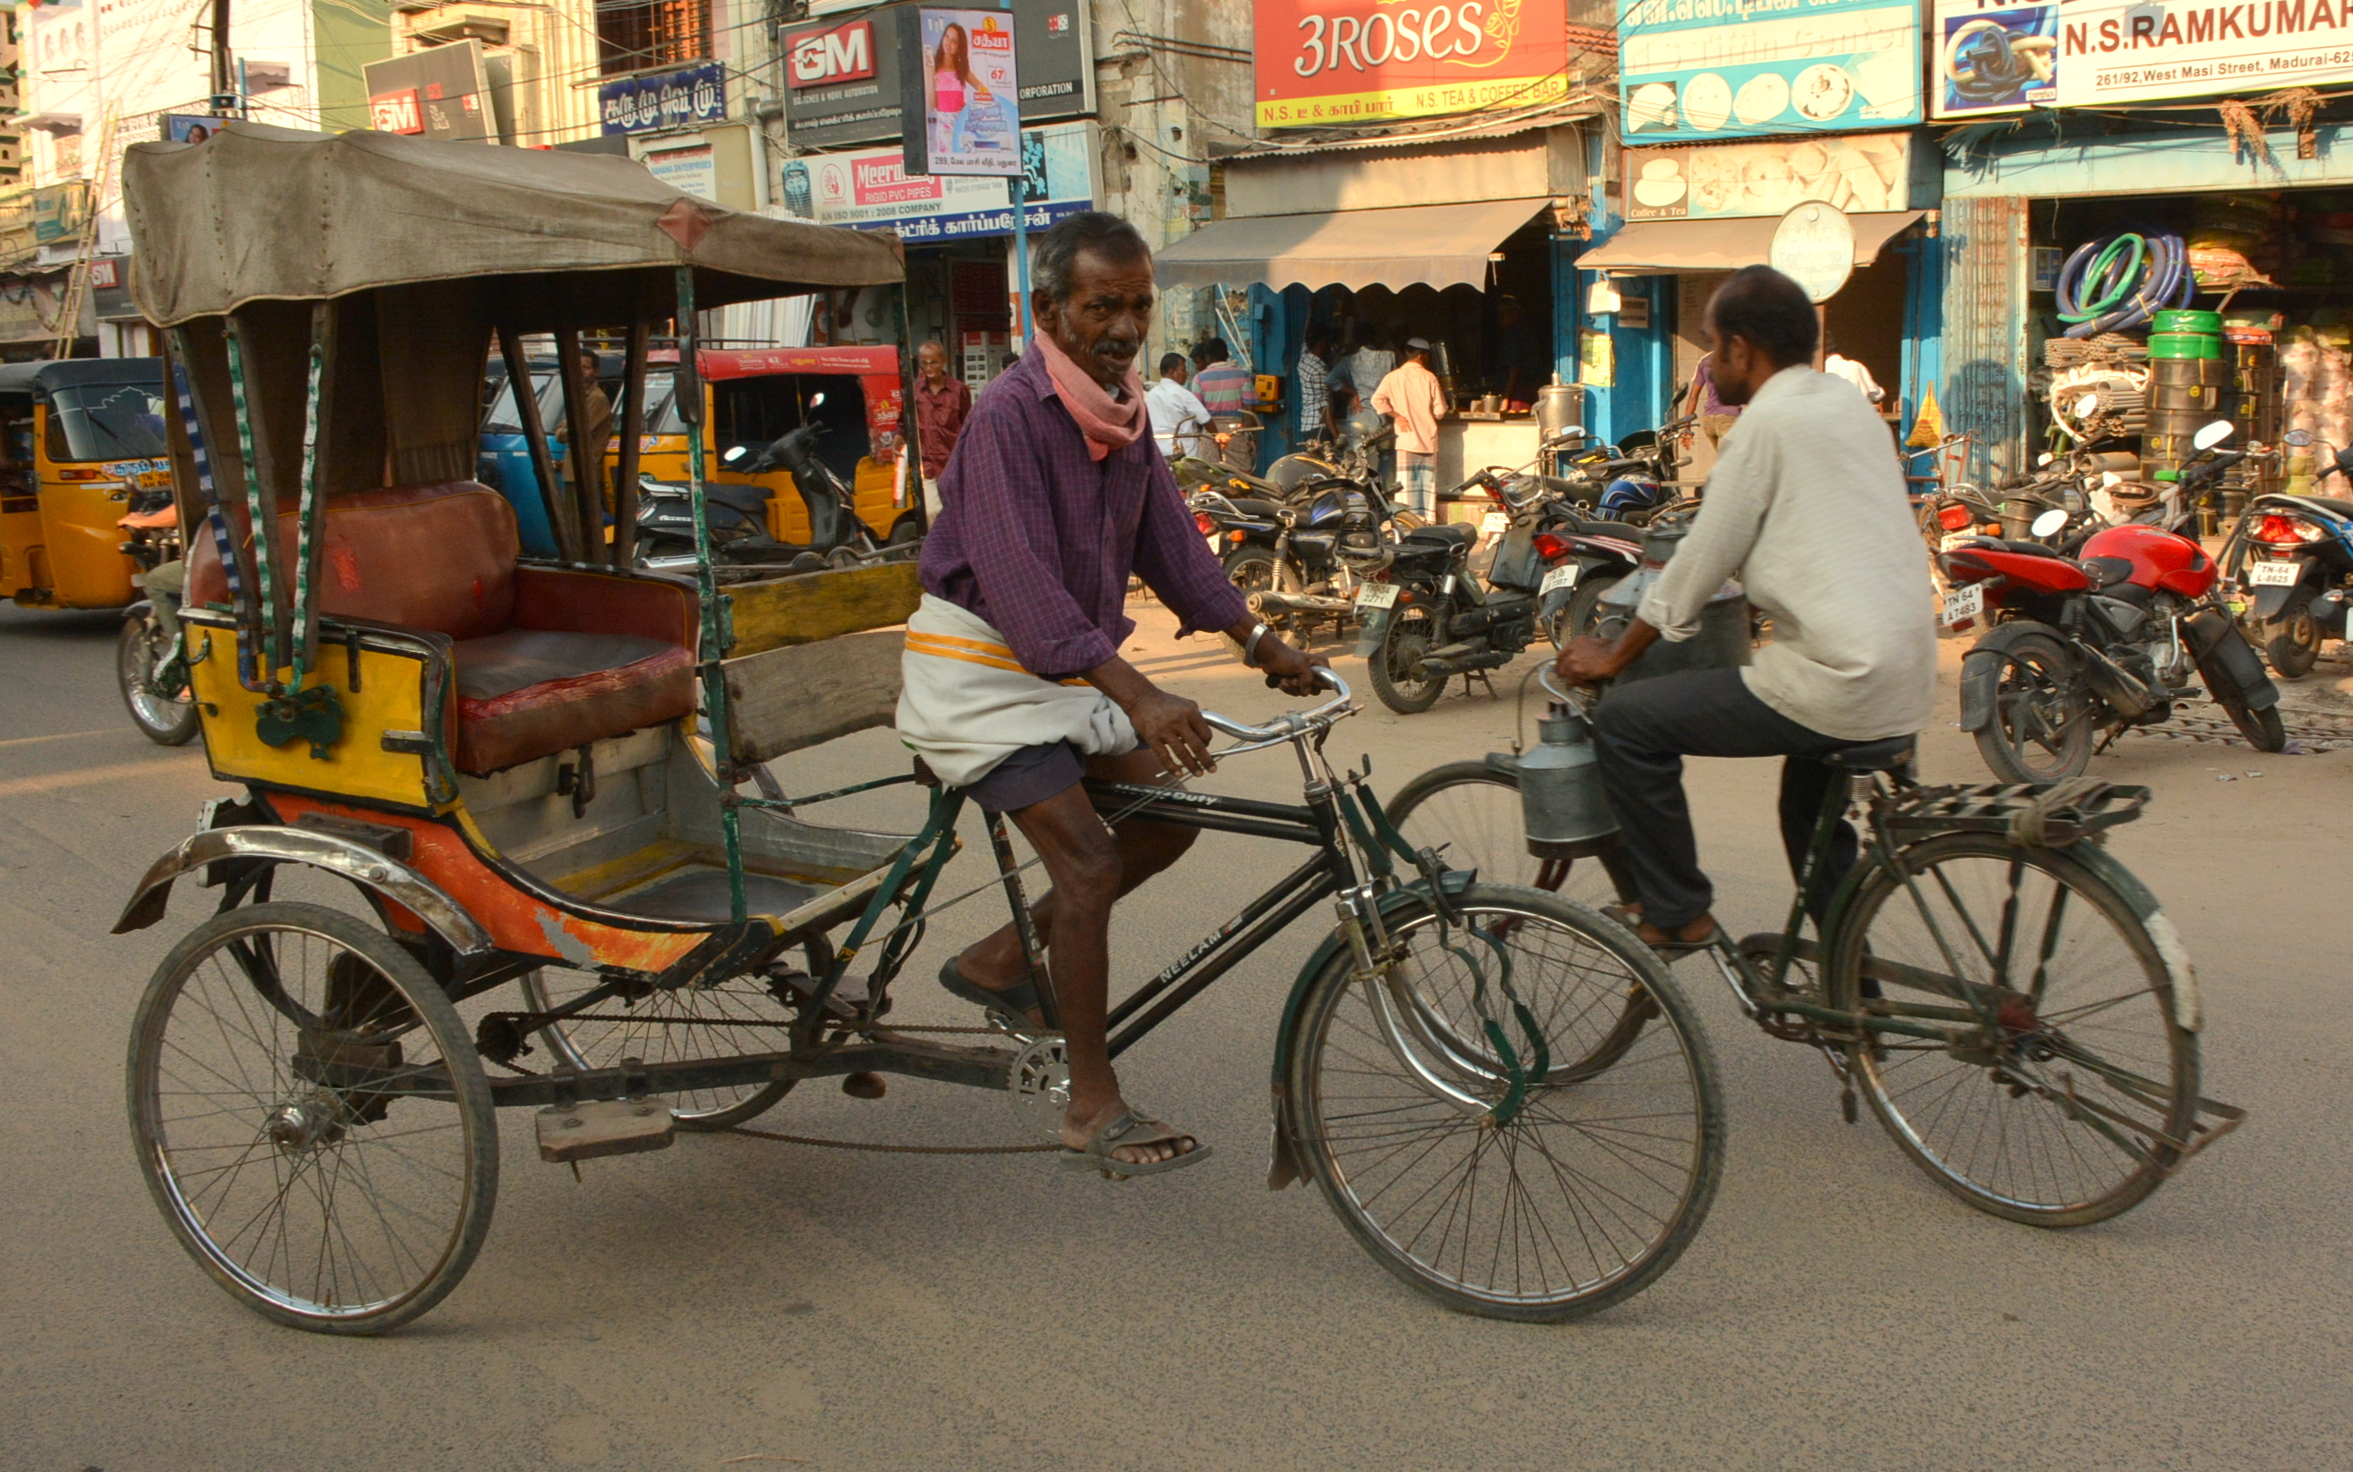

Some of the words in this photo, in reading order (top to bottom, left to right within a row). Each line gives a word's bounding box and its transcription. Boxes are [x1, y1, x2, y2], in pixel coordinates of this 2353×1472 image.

[792, 29, 869, 80] GM
[2182, 64, 2214, 79] Masi
[2218, 59, 2265, 76] Street,
[2270, 51, 2353, 70] Madurai-62
[991, 70, 1005, 80] 67
[1020, 81, 1073, 99] ORPORATION
[1416, 92, 1439, 108] N.S.
[1443, 91, 1465, 106] TEA
[1468, 89, 1477, 104] &
[1480, 83, 1529, 102] COFFEE
[1533, 80, 1559, 98] BAR
[1264, 106, 1292, 122] N.S.
[1312, 105, 1324, 117] &
[1328, 101, 1362, 116] காபி
[1365, 95, 1394, 114] பார்
[934, 156, 950, 166] 289,
[865, 191, 888, 204] RIGID
[889, 188, 906, 201] PVC
[906, 186, 932, 200] PIPES
[822, 211, 833, 221] AN
[834, 210, 848, 220] ISO
[850, 209, 869, 219] 9001
[876, 206, 896, 216] 2008
[898, 202, 942, 215] COMPANY
[1631, 208, 1658, 218] Coffee
[1660, 207, 1667, 217] &
[1670, 206, 1686, 217] Tea
[1947, 596, 1960, 607] TN
[1962, 590, 1974, 602] 64
[1955, 602, 1977, 617] 7483
[1172, 791, 1218, 806] Duty
[1160, 930, 1221, 984] NEELAM
